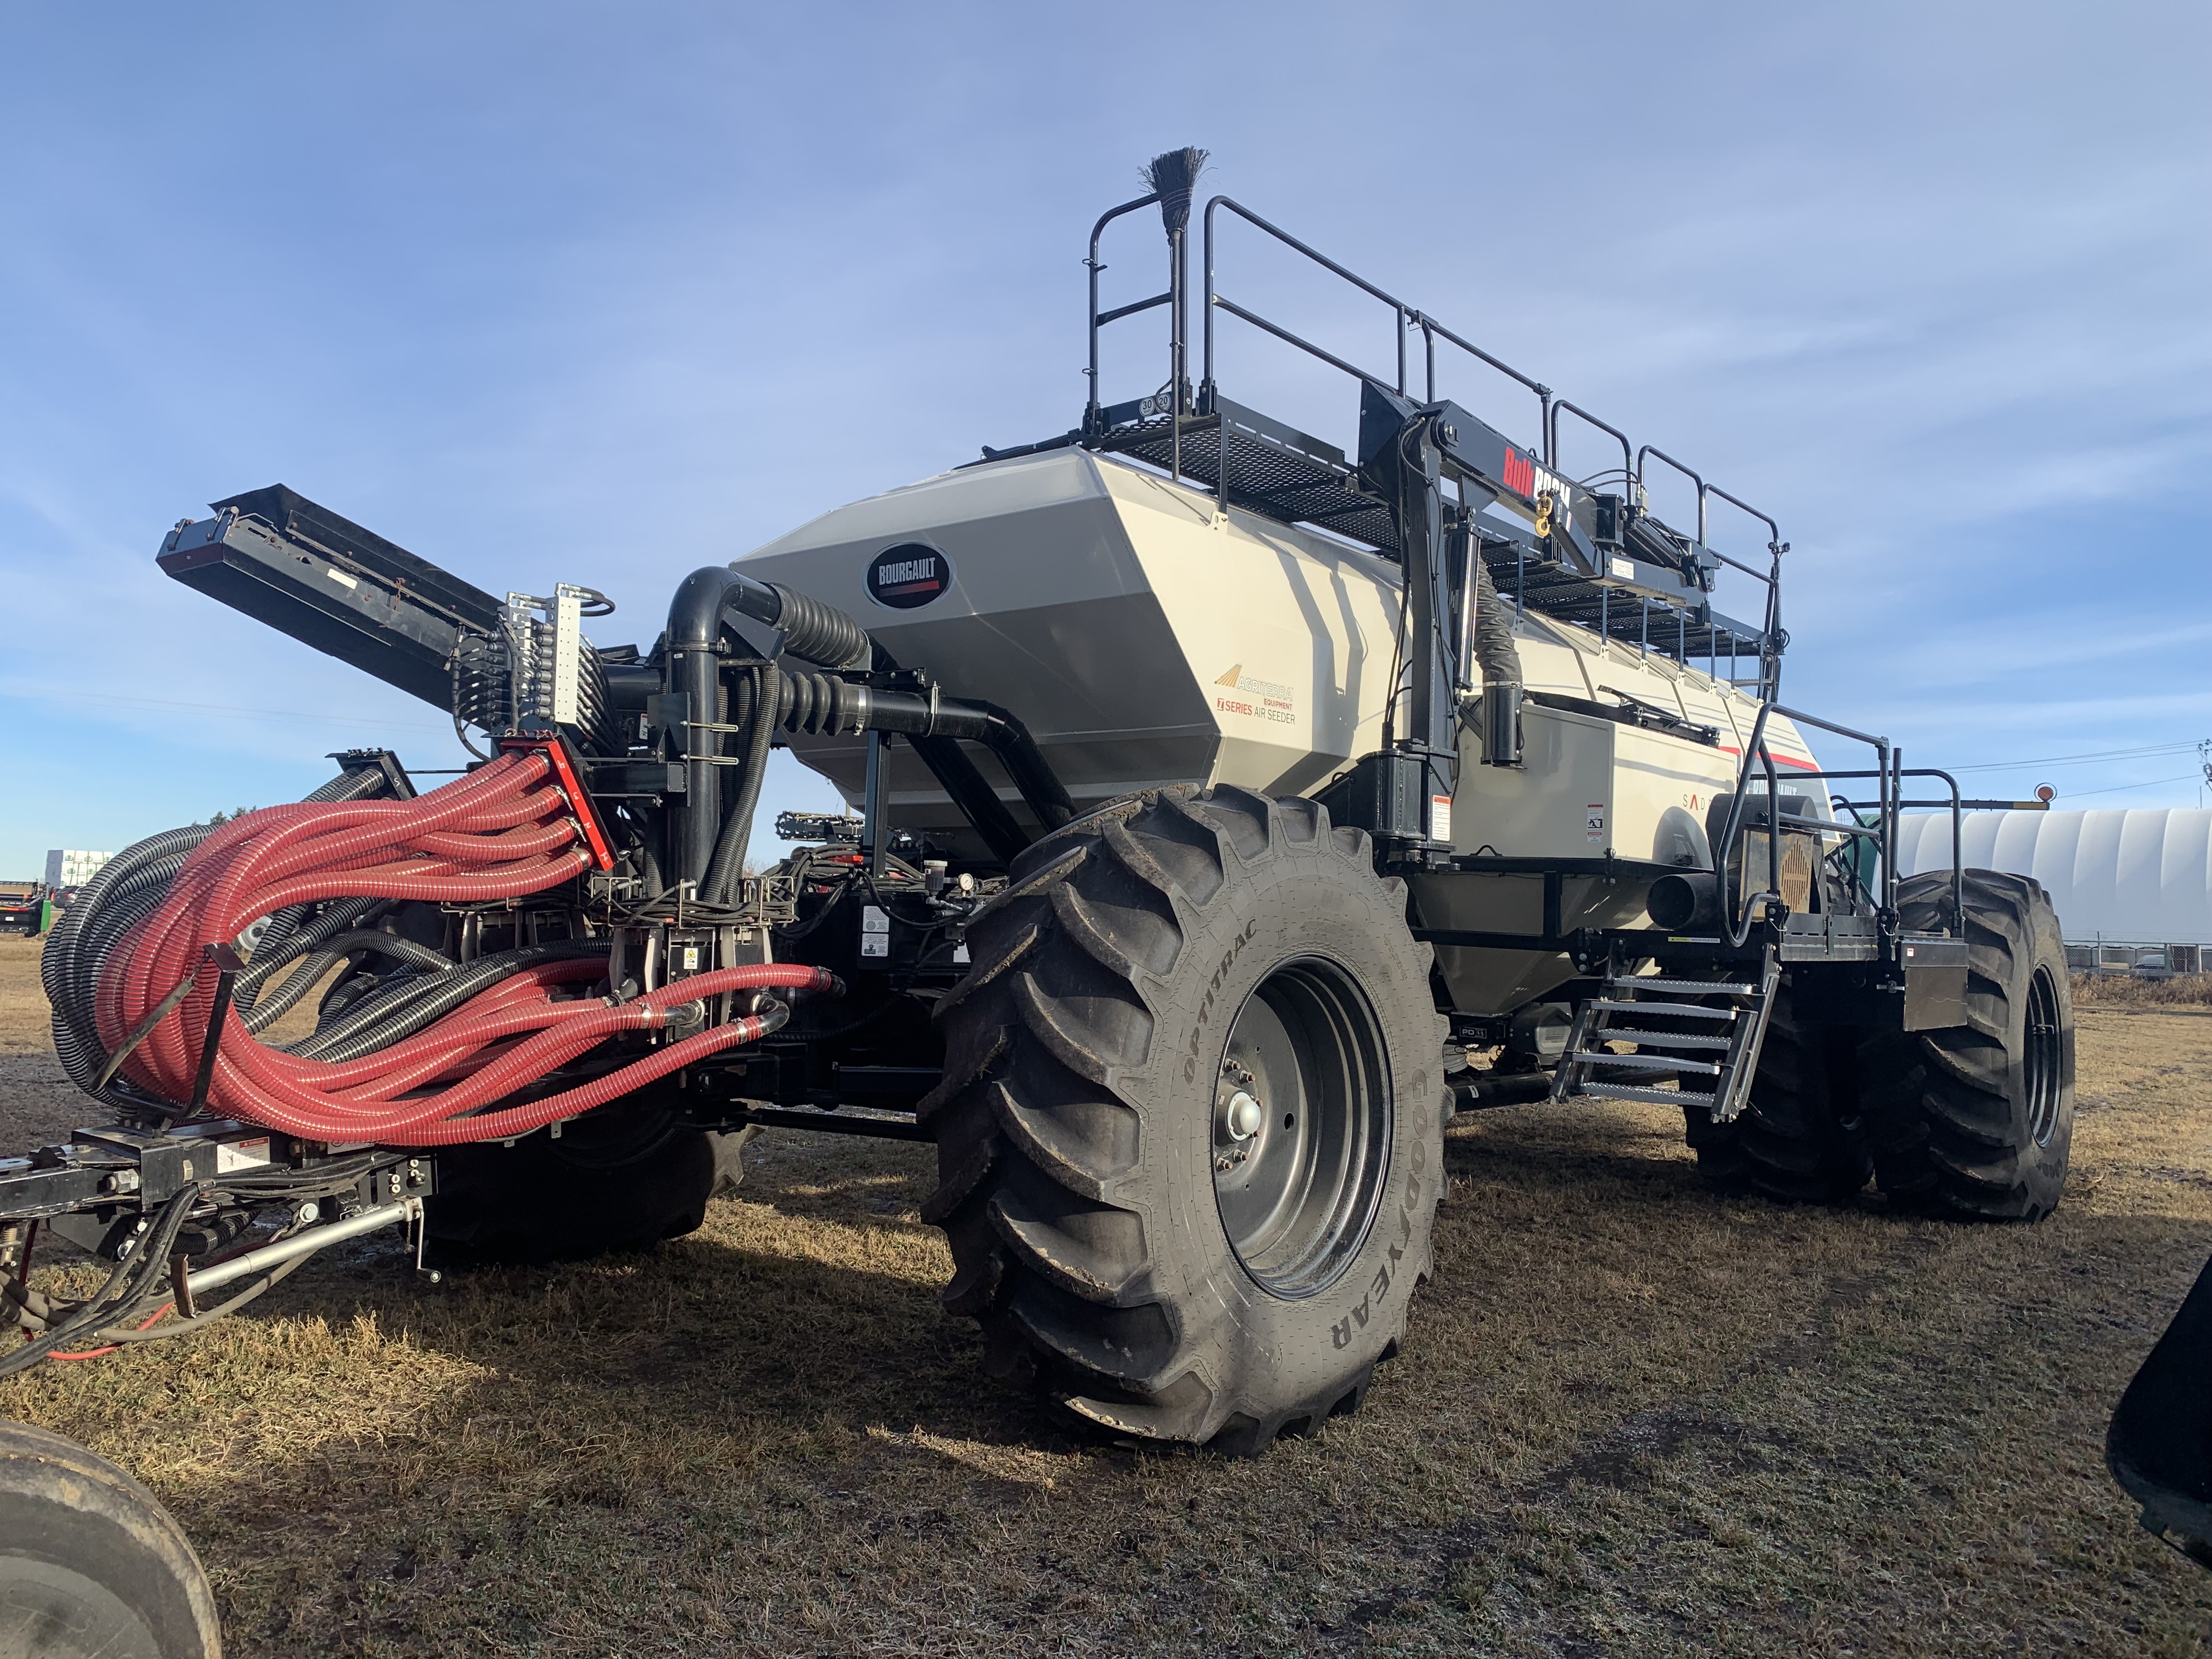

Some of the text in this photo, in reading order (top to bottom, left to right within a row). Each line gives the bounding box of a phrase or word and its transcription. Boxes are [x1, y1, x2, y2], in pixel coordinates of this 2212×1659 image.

[1142, 399, 1152, 410] 30
[1159, 396, 1168, 405] 20
[1503, 446, 1534, 498] Bulk
[879, 557, 935, 585] BOURGAULT
[1238, 676, 1293, 701] AGRITERRA
[1225, 701, 1252, 716] SERIES
[1254, 706, 1266, 719] AIR
[1267, 709, 1295, 725] SEEDER
[1263, 698, 1293, 710] EQUIPMENT
[1184, 918, 1257, 1085] OPTITRAC
[1331, 1068, 1428, 1351] GOODYEAR
